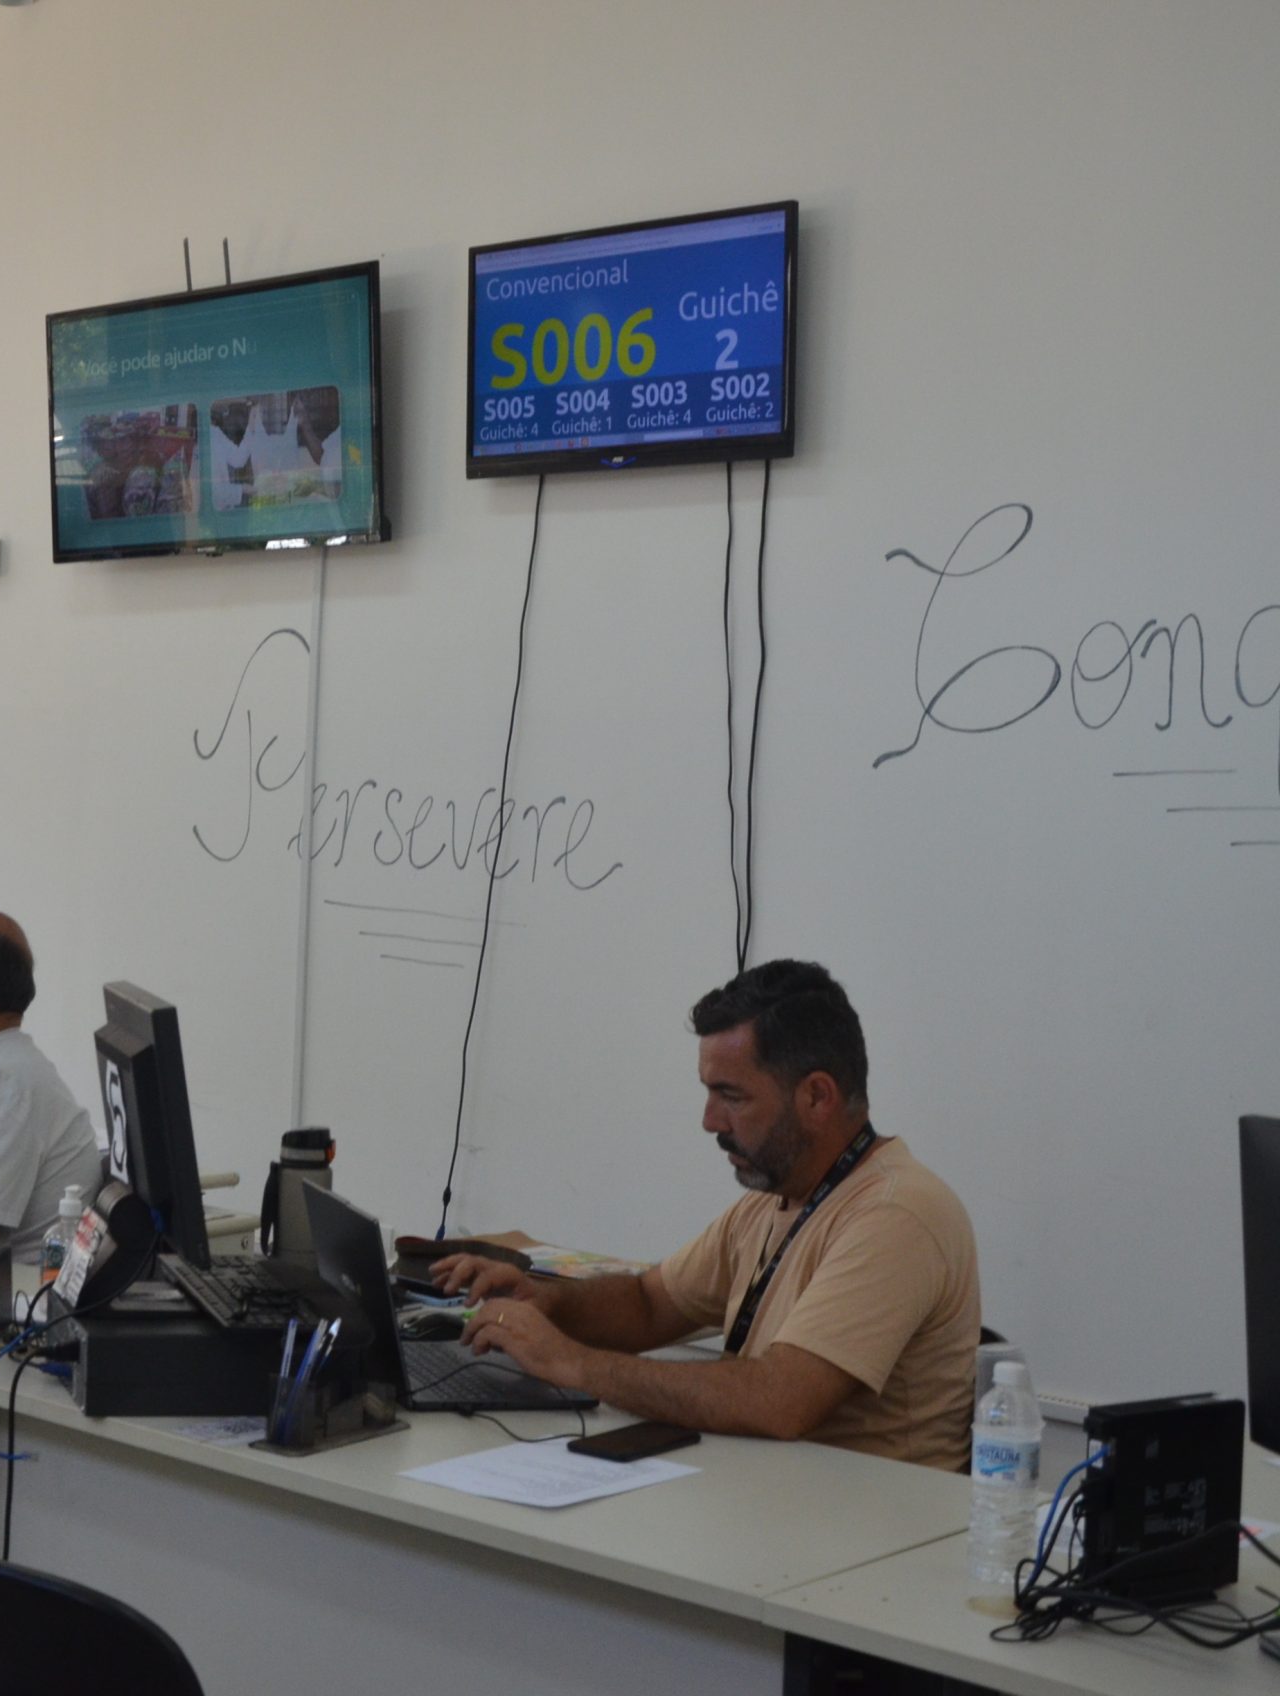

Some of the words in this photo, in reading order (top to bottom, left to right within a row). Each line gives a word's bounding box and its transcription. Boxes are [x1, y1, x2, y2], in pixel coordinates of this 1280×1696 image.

[486, 259, 629, 301] Convencional
[679, 280, 778, 321] Guichê
[121, 350, 161, 377] pode
[164, 343, 215, 369] ajudar
[218, 344, 229, 358] o
[490, 307, 657, 390] S006
[715, 329, 739, 371] 2
[631, 381, 688, 408] S003
[710, 372, 770, 402] S002
[484, 395, 535, 421] S005
[555, 388, 611, 415] S004
[682, 408, 692, 423] 4
[765, 402, 774, 417] 2
[530, 422, 539, 437] 4
[606, 416, 612, 430] 1
[192, 627, 624, 891] Persevere
